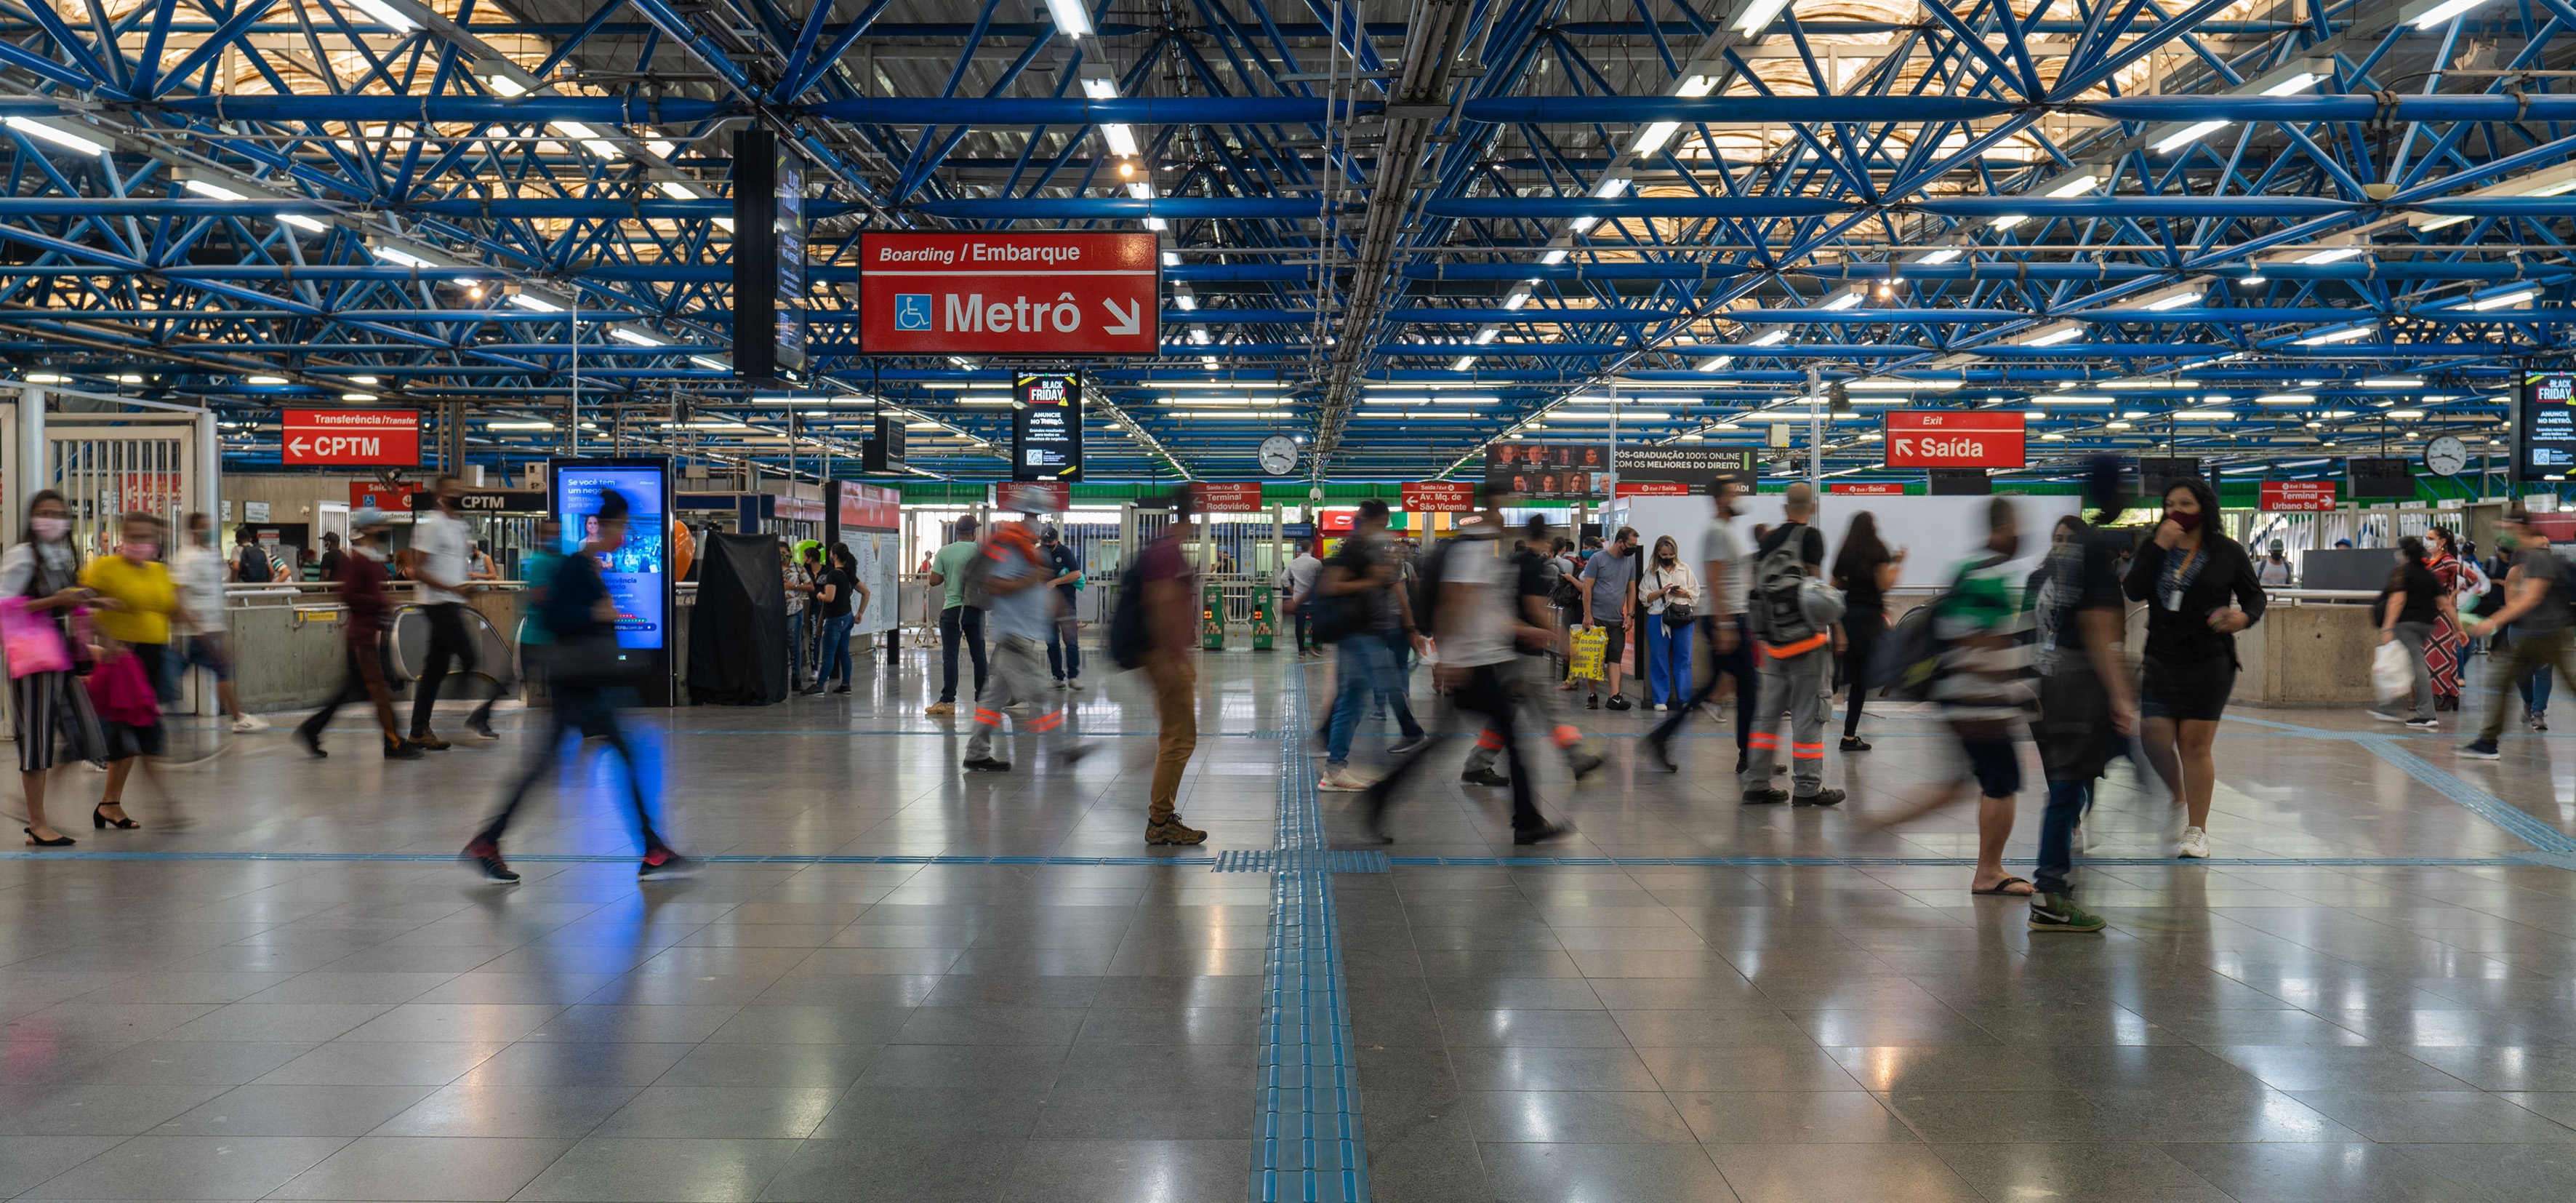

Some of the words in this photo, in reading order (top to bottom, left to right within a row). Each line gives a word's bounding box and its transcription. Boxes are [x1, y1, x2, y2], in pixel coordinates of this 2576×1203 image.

[880, 247, 955, 265] Boarding
[973, 243, 1080, 265] Embarque
[945, 292, 1081, 332] Metrô
[1042, 380, 1064, 388] BLACK
[2550, 379, 2572, 388] BLACK
[1031, 388, 1064, 401] FRIDAY
[2538, 387, 2572, 400] FRIDAY
[314, 414, 381, 424] Transferência
[1923, 416, 1943, 425] Exit
[314, 436, 380, 457] CPTM
[1920, 437, 1983, 457] Saída
[1685, 452, 1708, 460] 100%
[1709, 452, 1740, 460] ONLINE
[1615, 460, 1632, 468] COM
[1634, 460, 1645, 468] OS
[1647, 461, 1692, 469] MELHORES
[1707, 462, 1741, 470] DIREITO
[1207, 493, 1242, 501] Terminal
[1435, 494, 1449, 502] Mq.
[2282, 492, 2318, 500] Terminal
[461, 496, 505, 508] CPTM
[2303, 502, 2318, 510] Sul
[1207, 503, 1250, 511] Rodoviário
[1419, 503, 1435, 511] São
[1437, 503, 1467, 511] Vicente
